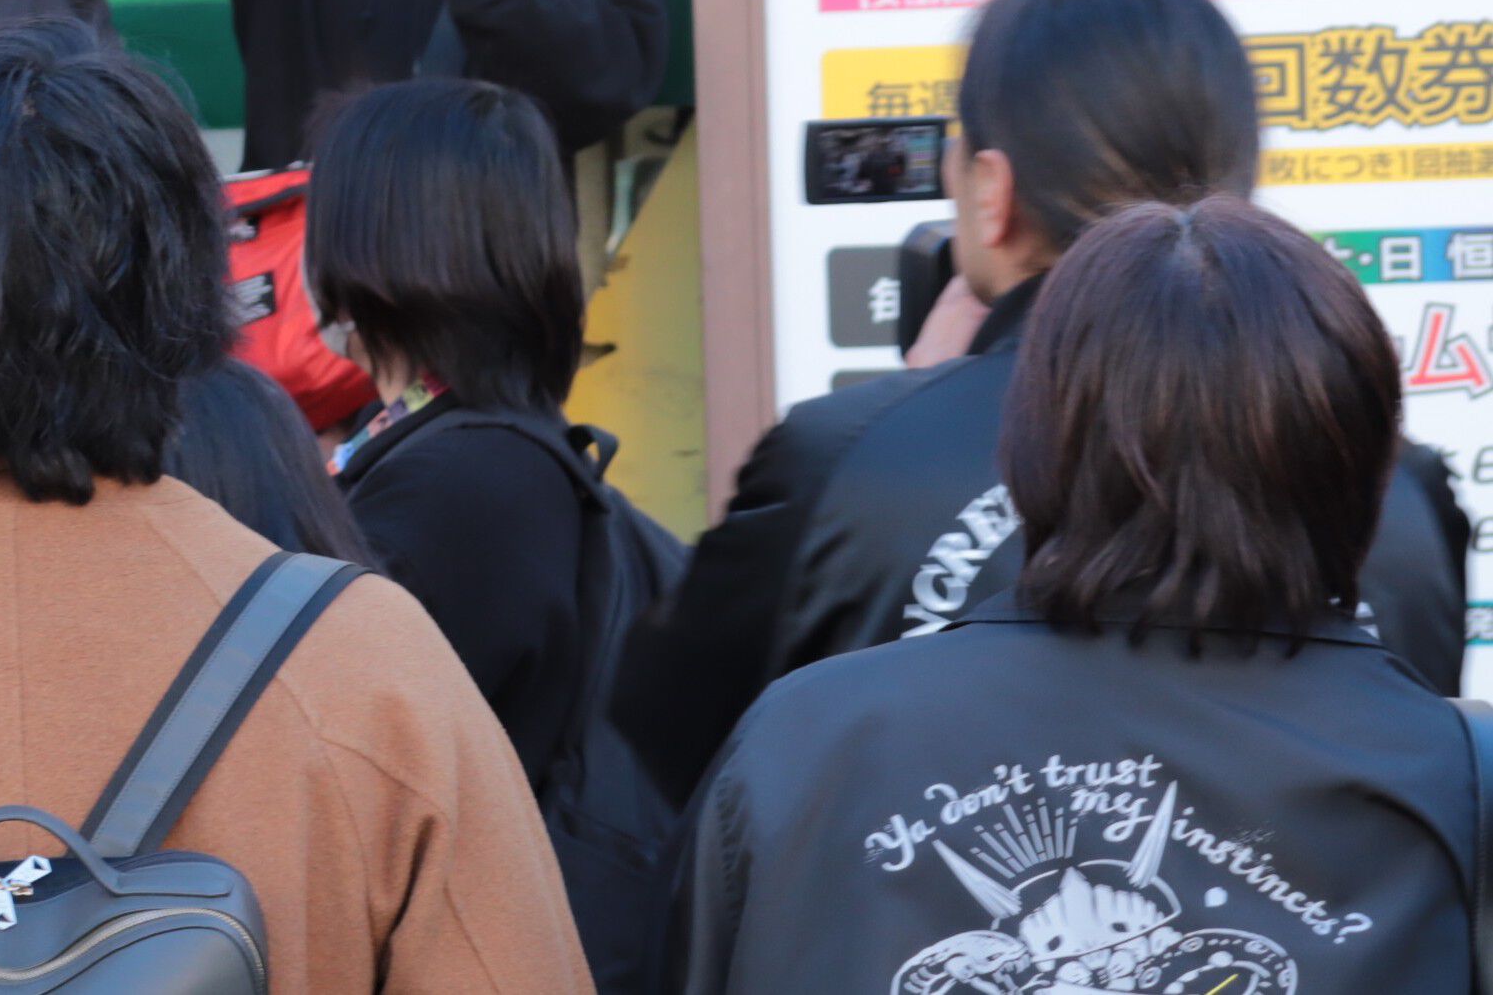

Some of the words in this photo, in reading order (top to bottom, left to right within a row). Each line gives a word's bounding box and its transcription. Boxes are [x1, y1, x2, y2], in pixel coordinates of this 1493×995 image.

[1039, 753, 1163, 790] trust
[1069, 787, 1154, 843] my
[1170, 806, 1374, 945] instincts?
